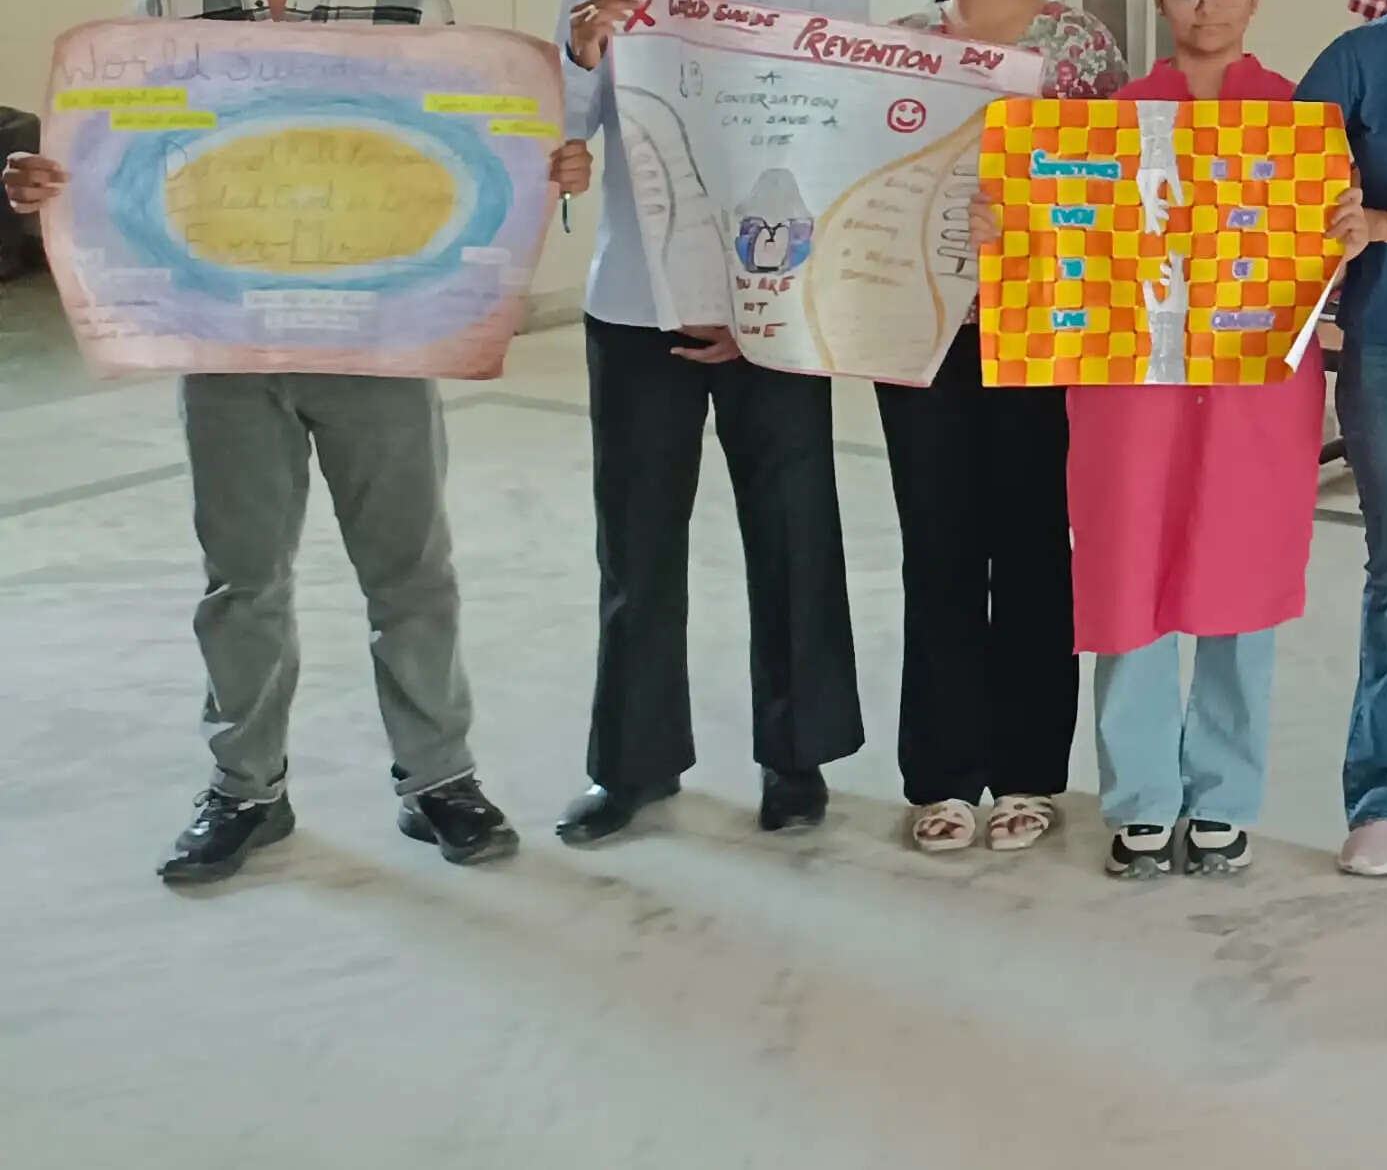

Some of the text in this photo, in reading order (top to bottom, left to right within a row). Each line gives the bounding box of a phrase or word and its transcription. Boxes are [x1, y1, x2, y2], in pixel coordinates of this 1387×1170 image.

[792, 16, 943, 75] PREVENTION
[959, 46, 1005, 70] DAY
[755, 70, 782, 86] A
[821, 115, 839, 128] A
